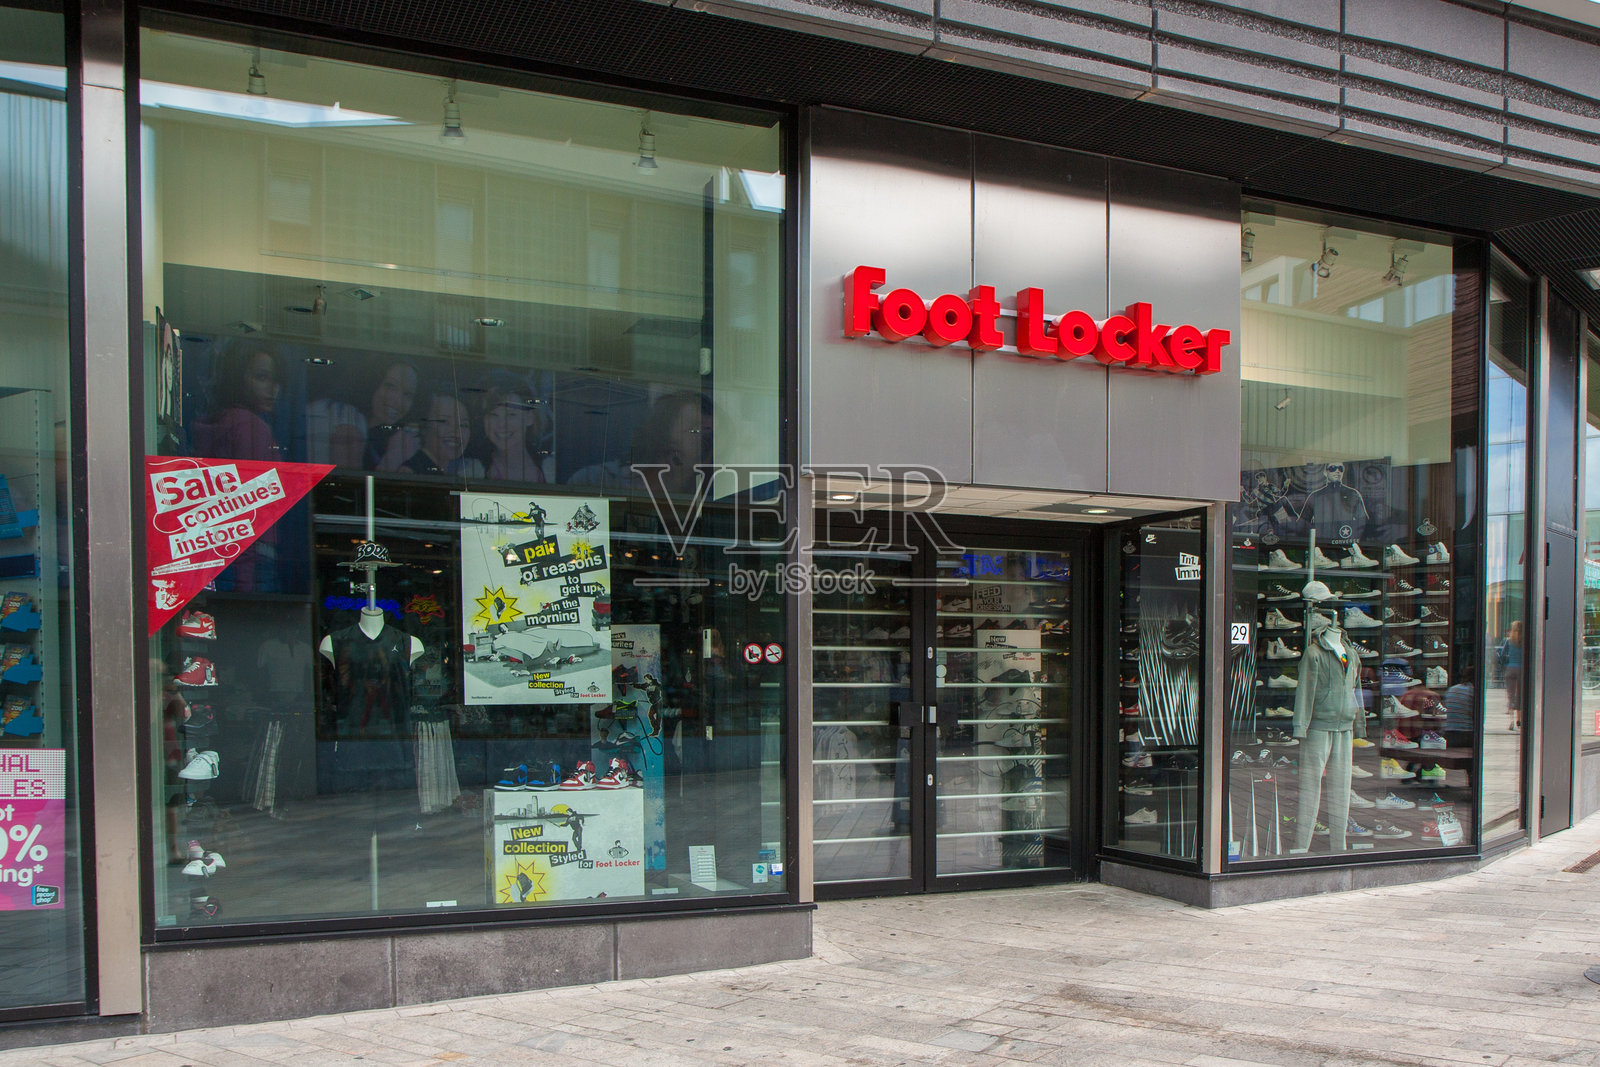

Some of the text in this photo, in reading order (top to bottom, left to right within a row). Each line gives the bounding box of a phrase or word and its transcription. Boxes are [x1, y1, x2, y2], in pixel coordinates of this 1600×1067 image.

[843, 265, 1231, 375] Foot Locker
[156, 469, 238, 505] Sale
[184, 482, 281, 528] continues
[175, 523, 250, 555] instore
[524, 540, 556, 563] pair
[522, 554, 603, 581] of reasons
[567, 575, 579, 585] to
[561, 584, 597, 598] get up
[551, 599, 578, 611] in the
[526, 611, 578, 625] morning
[1231, 625, 1248, 641] 29
[533, 672, 550, 681] New
[512, 826, 542, 840] New
[504, 842, 567, 853] collection
[551, 851, 584, 864] Styled
[579, 860, 593, 868] for
